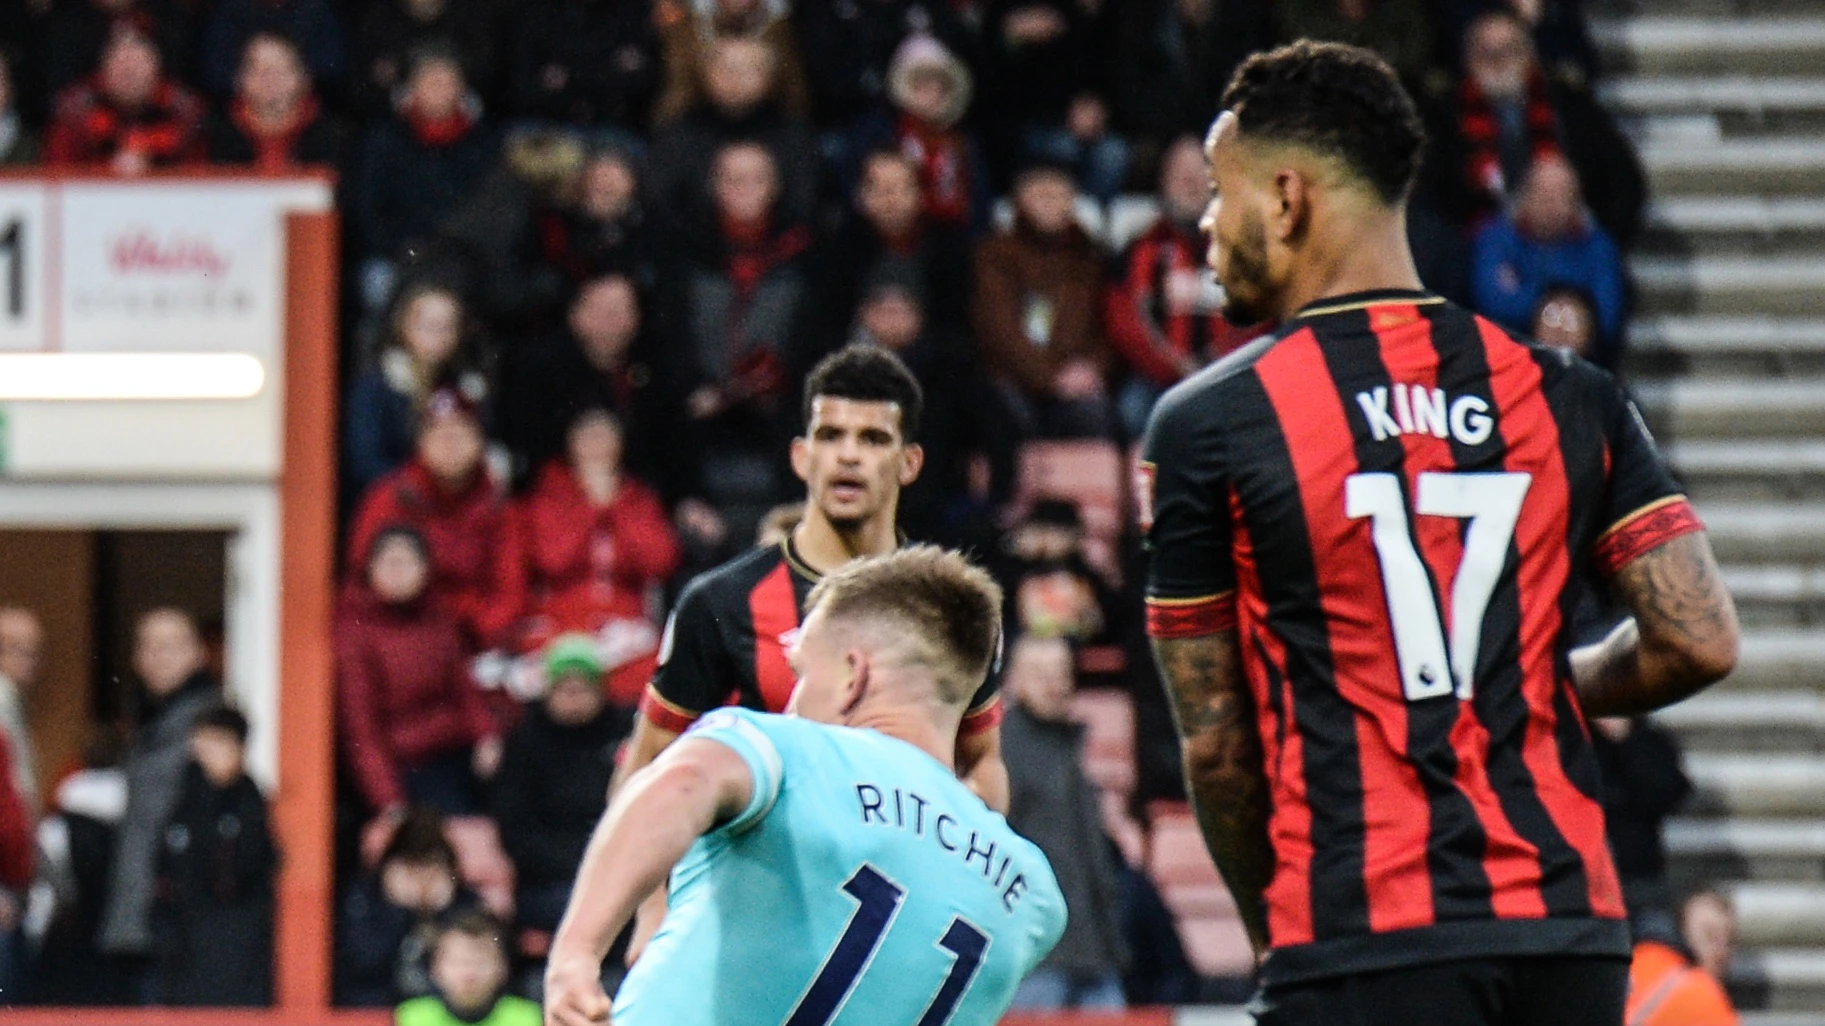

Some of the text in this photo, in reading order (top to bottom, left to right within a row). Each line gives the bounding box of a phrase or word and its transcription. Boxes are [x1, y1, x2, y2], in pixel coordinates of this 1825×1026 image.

[1355, 382, 1494, 446] KING
[1343, 470, 1533, 701] 17
[853, 782, 1030, 916] RITCHIE
